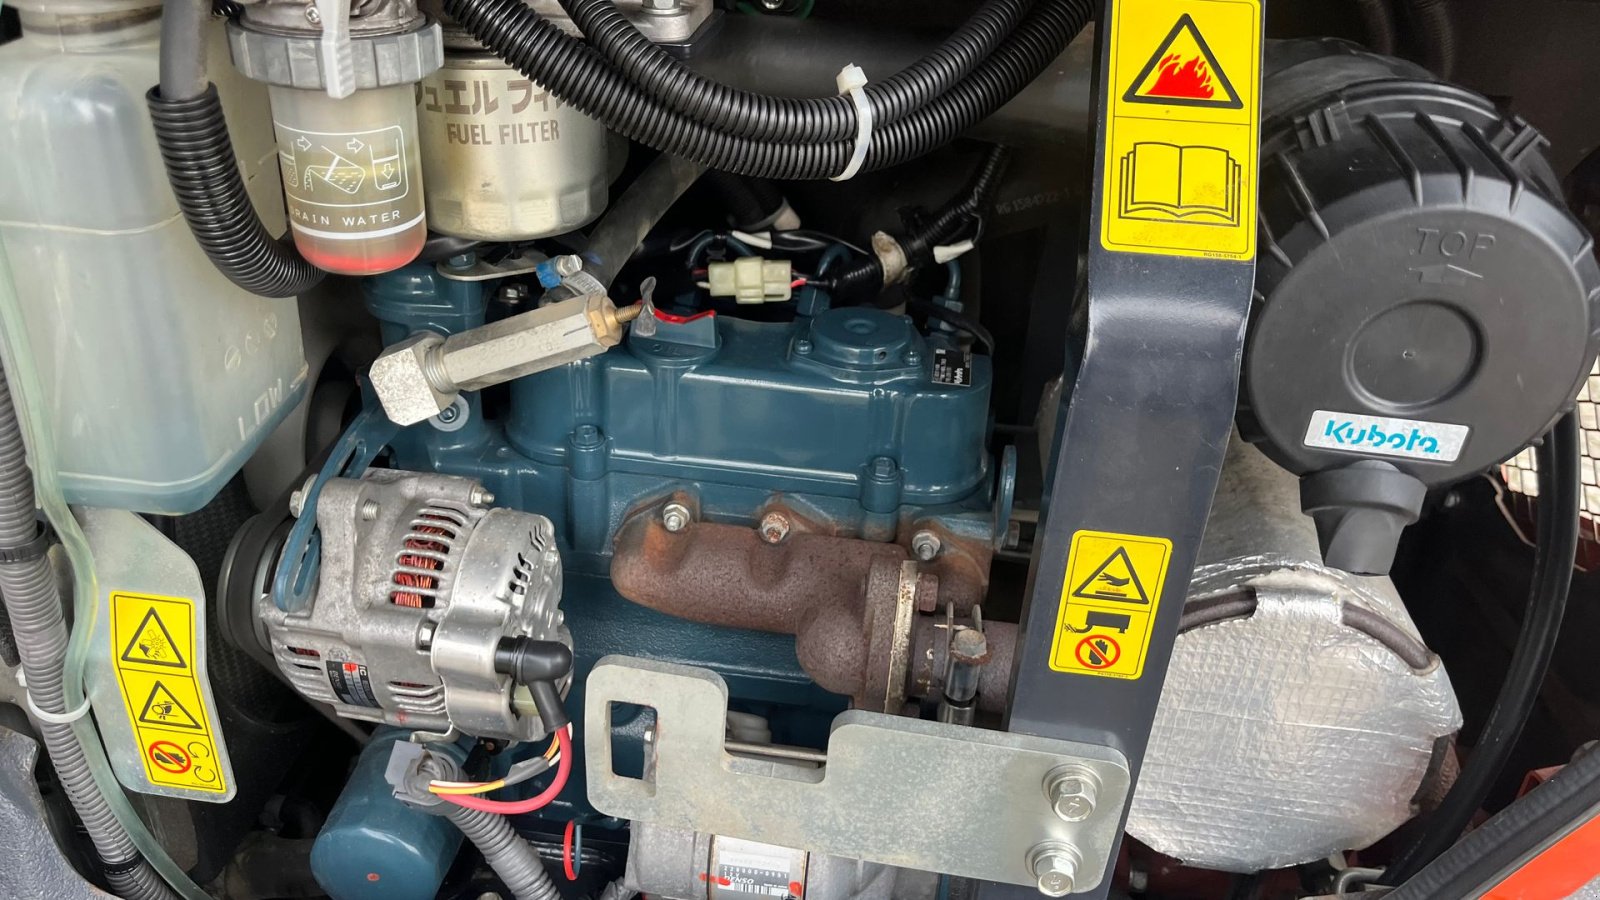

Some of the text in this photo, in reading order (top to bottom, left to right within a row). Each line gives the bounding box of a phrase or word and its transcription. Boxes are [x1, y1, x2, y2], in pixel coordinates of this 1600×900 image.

[447, 119, 560, 145] FUEL FILTER
[342, 209, 400, 226] WATER
[1416, 227, 1496, 260] TOP
